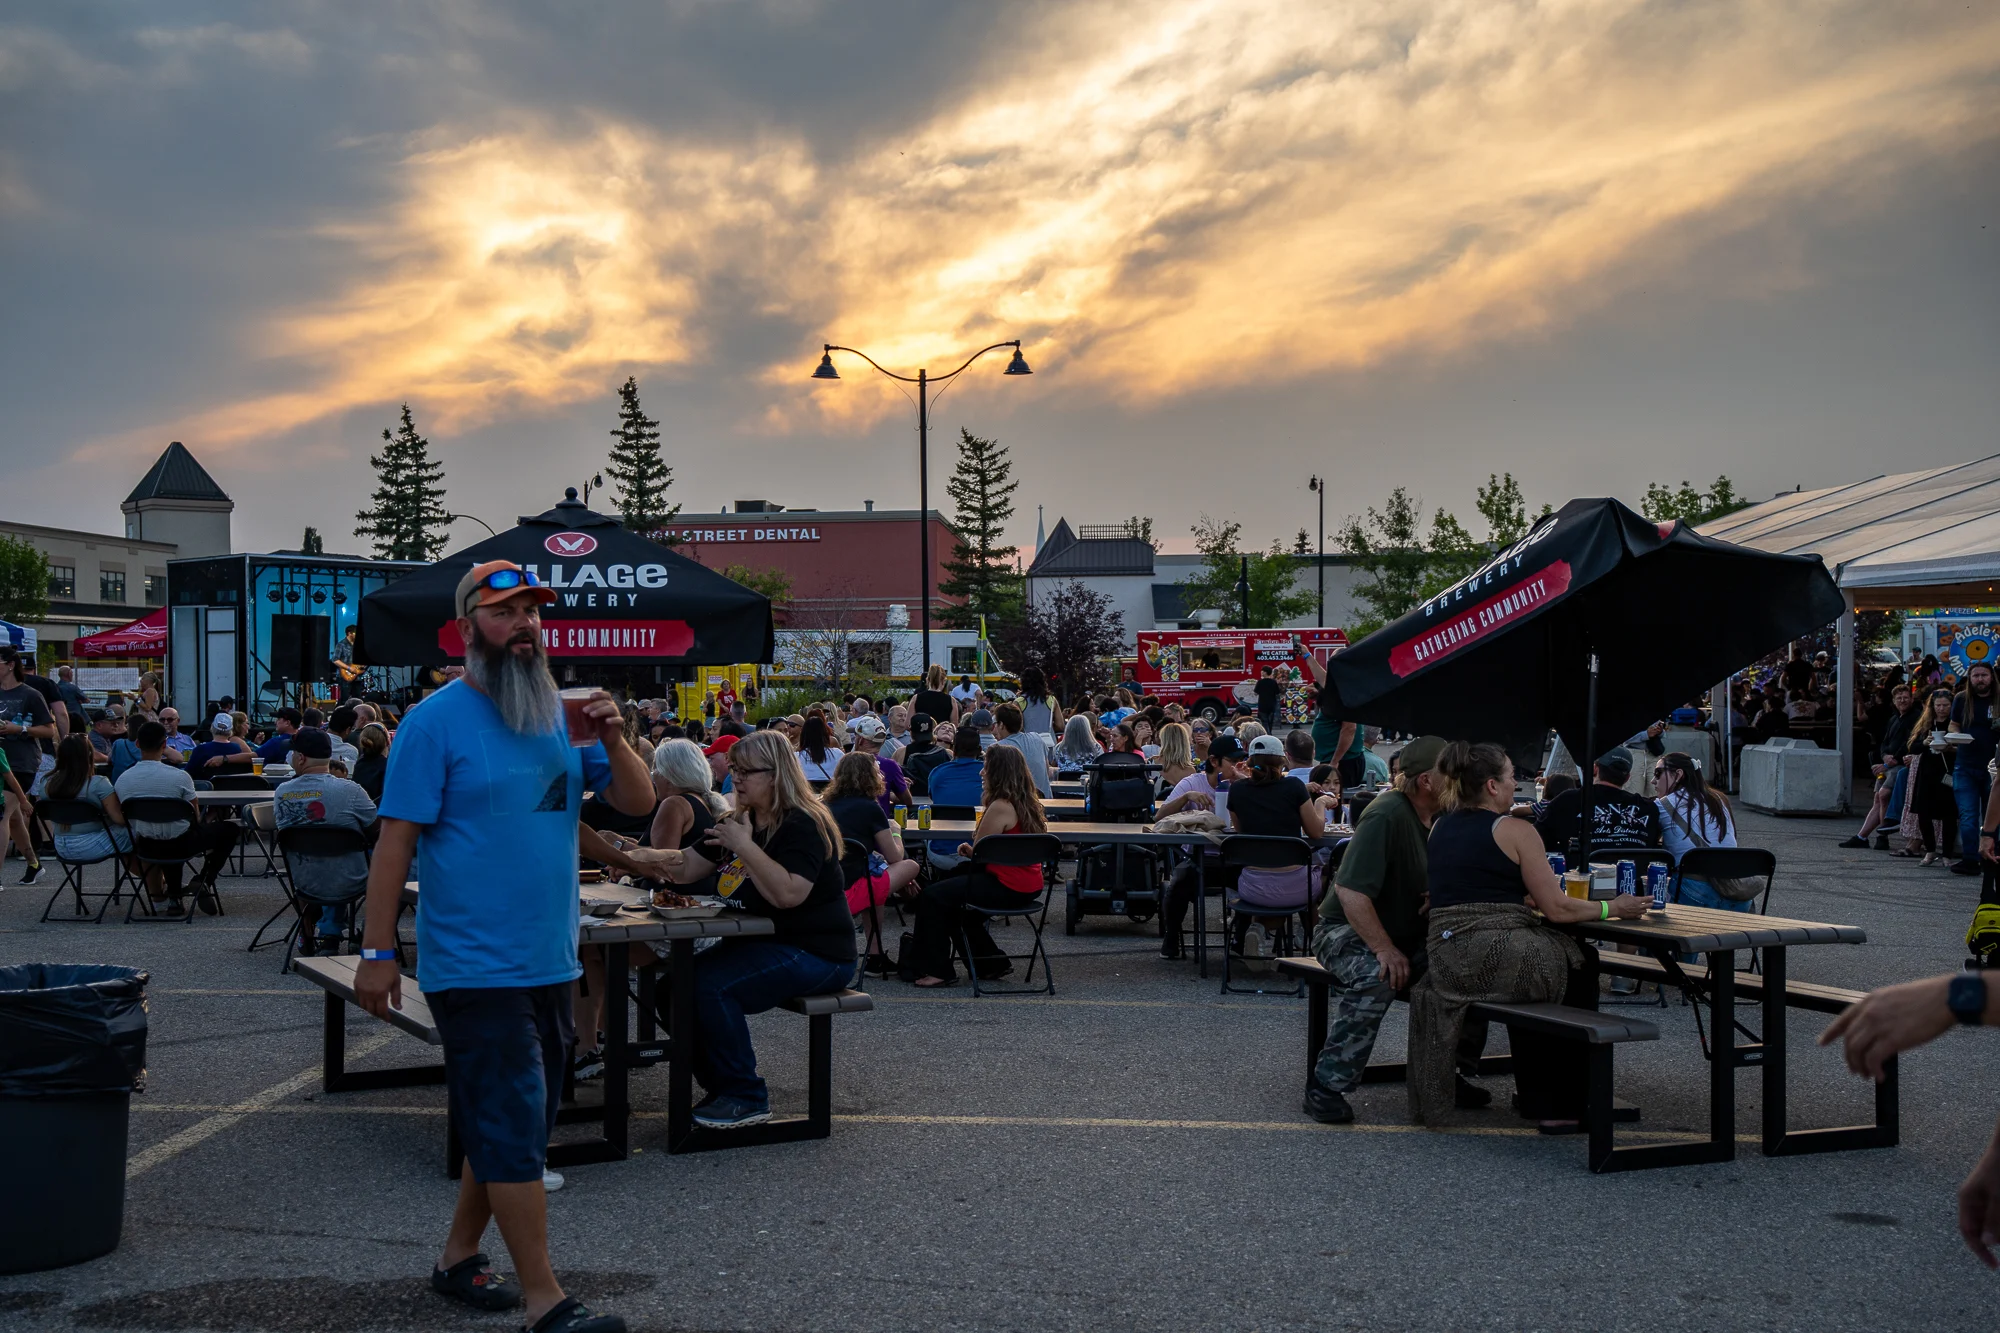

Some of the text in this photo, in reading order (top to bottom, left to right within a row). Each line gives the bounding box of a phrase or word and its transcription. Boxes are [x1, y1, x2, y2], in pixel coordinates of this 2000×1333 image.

[682, 530, 747, 542] STREET
[754, 528, 821, 541] DENTAL
[473, 563, 668, 588] LLAGE
[1425, 554, 1523, 617] BREWERY
[1413, 578, 1546, 661] GATHERING COMMUNITY
[568, 628, 656, 648] COMMUNITY
[1234, 738, 1243, 749] R
[1592, 803, 1649, 828] ANTA
[1622, 869, 1634, 884] PET
